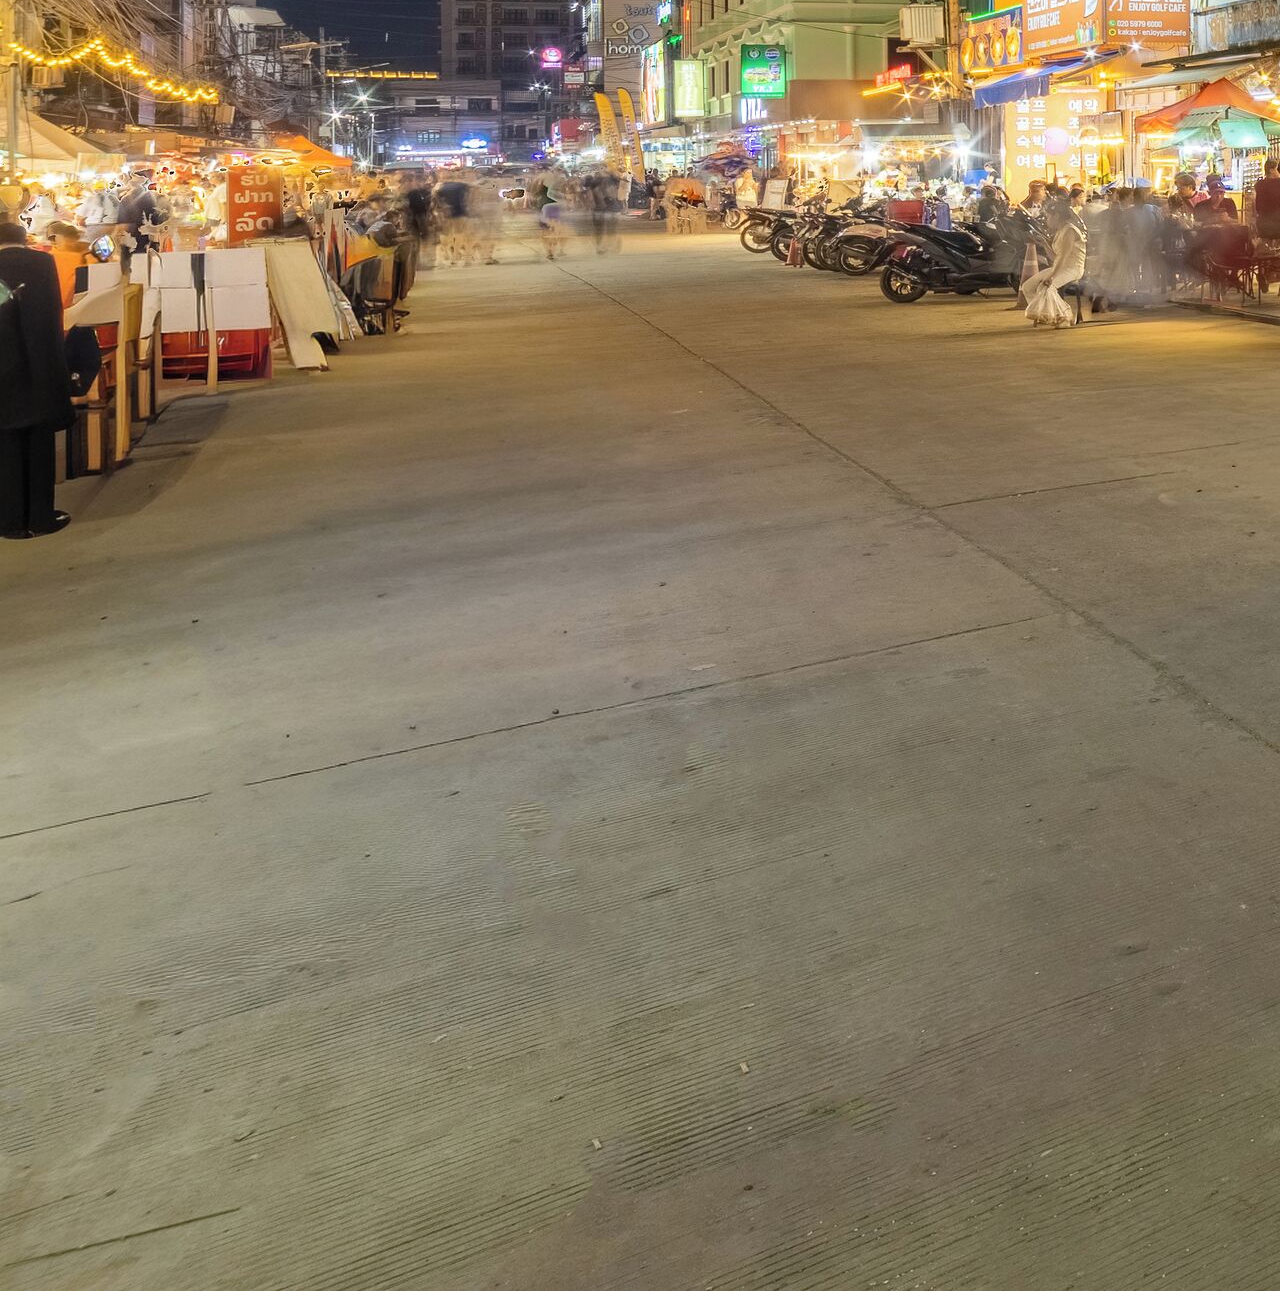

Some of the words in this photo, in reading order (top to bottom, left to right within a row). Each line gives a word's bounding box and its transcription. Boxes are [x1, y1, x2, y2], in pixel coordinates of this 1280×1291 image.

[1128, 2, 1150, 12] ENJOY
[1151, 3, 1168, 12] GOLF
[1169, 3, 1187, 13] CAFE
